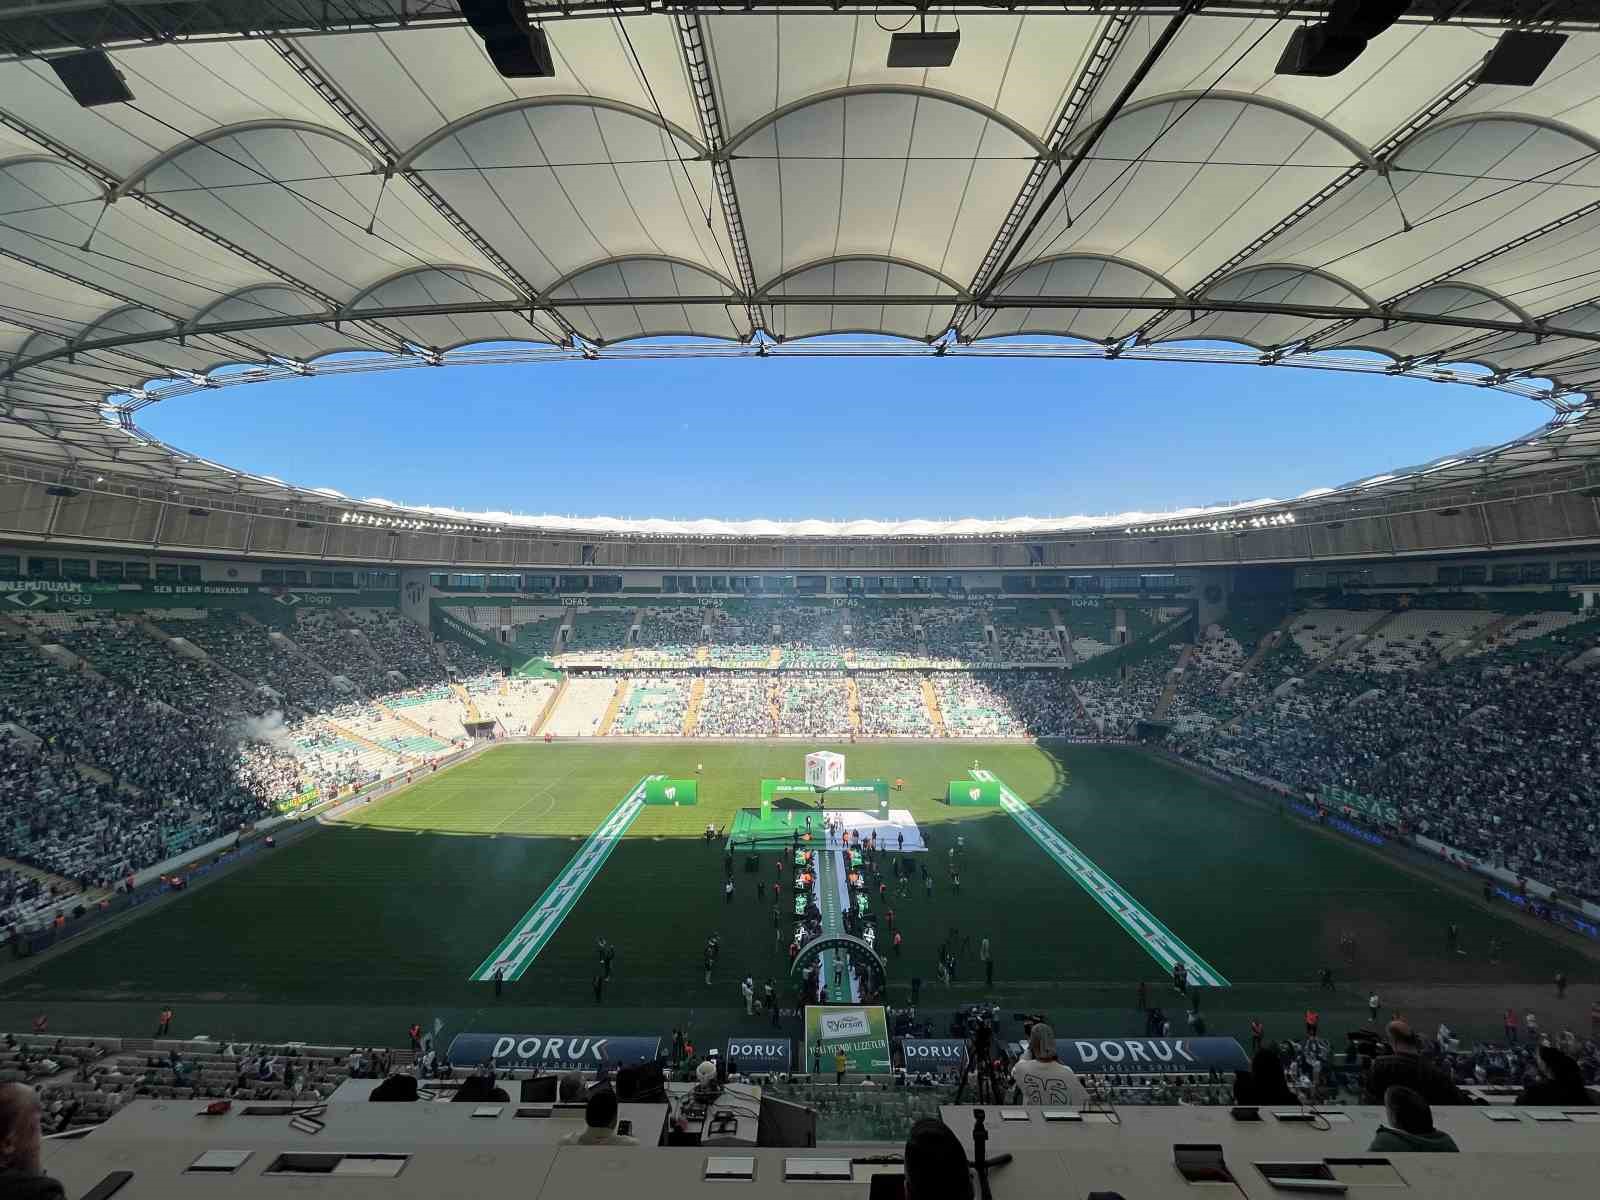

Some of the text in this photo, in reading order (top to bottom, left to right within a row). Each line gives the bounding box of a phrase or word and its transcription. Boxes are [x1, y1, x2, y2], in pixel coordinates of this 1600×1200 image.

[55, 592, 92, 605] Togg
[304, 594, 332, 605] Togg
[491, 1036, 609, 1060] DORUK
[730, 1044, 785, 1057] DORUK
[906, 1045, 960, 1057] DORUK
[1074, 1040, 1195, 1063] DORUK
